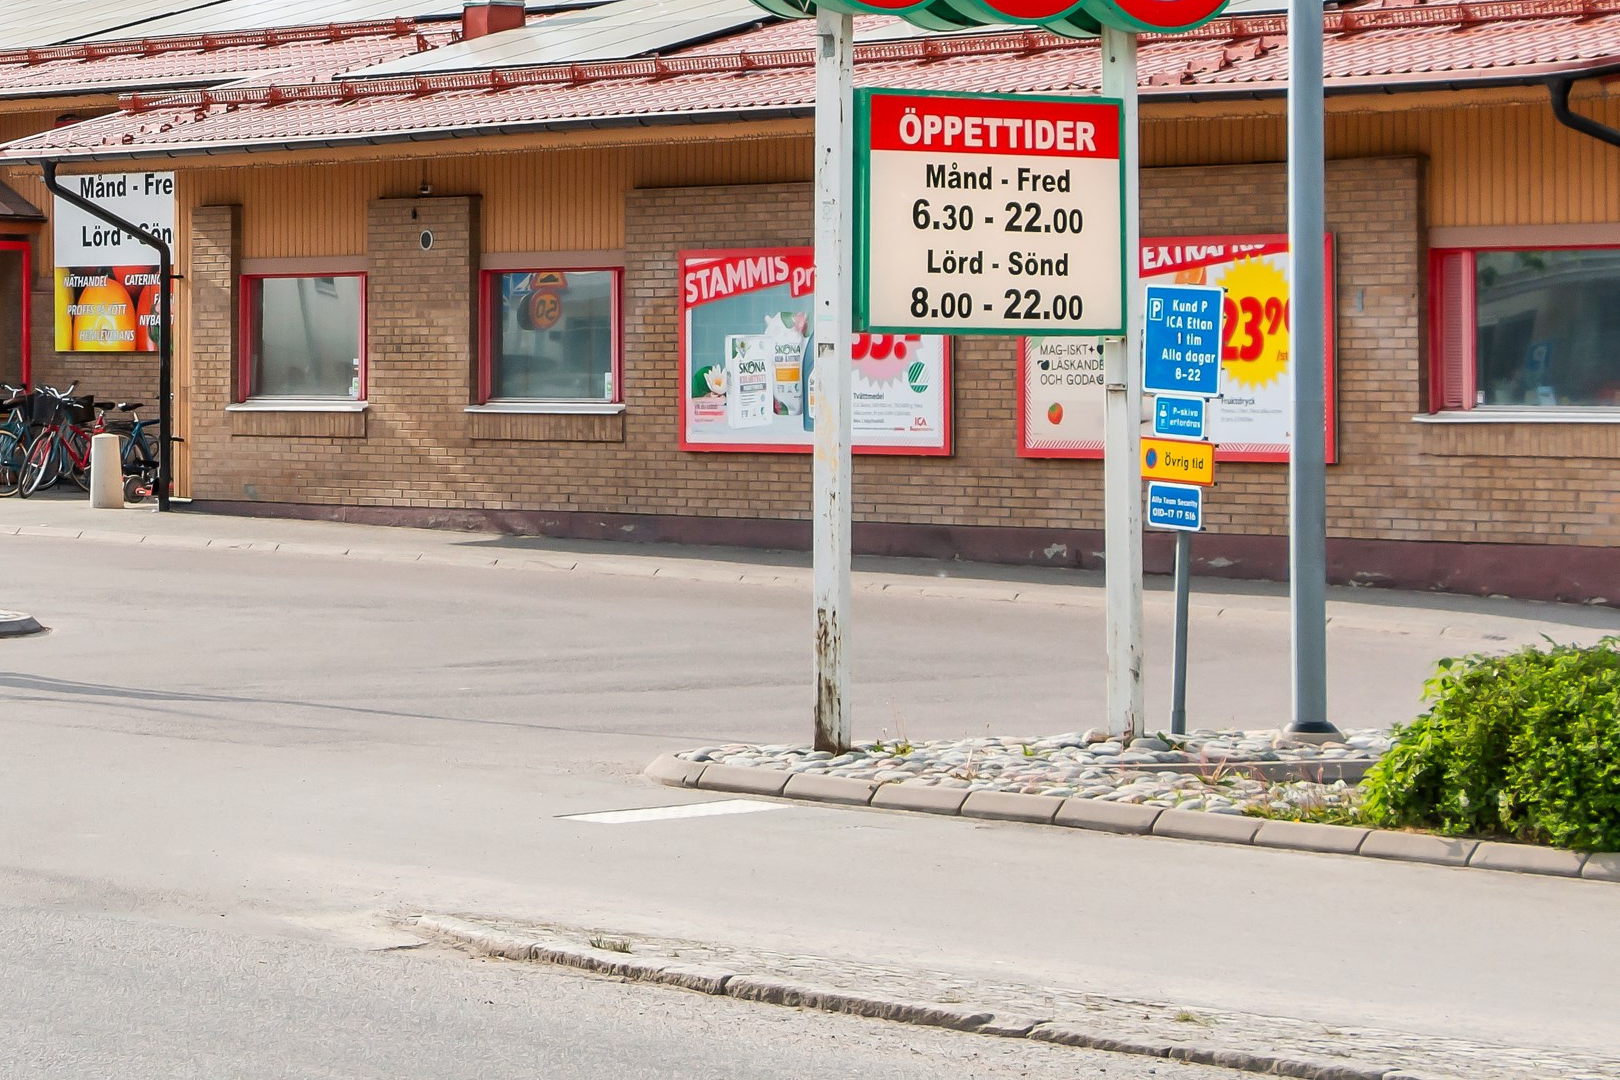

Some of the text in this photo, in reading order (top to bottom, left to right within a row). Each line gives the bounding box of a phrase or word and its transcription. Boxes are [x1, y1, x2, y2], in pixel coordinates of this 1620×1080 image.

[898, 107, 1097, 152] ÖPPETTIDER
[80, 174, 127, 198] Månd
[144, 173, 173, 196] Fre
[926, 162, 993, 190] Månd
[1017, 168, 1071, 193] Fred
[912, 198, 974, 231] 6.30
[1004, 202, 1084, 235] 22.00
[82, 225, 121, 247] Lörd
[927, 249, 984, 274] Lörd
[1008, 251, 1069, 277] Sönd
[64, 274, 109, 287] NÄTHANDEL
[686, 256, 790, 304] STAMMIS
[910, 286, 973, 319] 8.00
[1003, 289, 1084, 321] 22.00
[1172, 299, 1208, 313] Kund P
[1166, 316, 1213, 330] ICA Ettan
[1177, 332, 1202, 345] 1 tim
[1040, 344, 1088, 355] MAG-ISKT
[1162, 348, 1216, 366] Alla dagar
[1051, 356, 1104, 370] LÄSKANDE
[1040, 374, 1096, 385] OCH GODA
[1175, 367, 1201, 382] 8-22
[1164, 451, 1204, 471] Övrig tid
